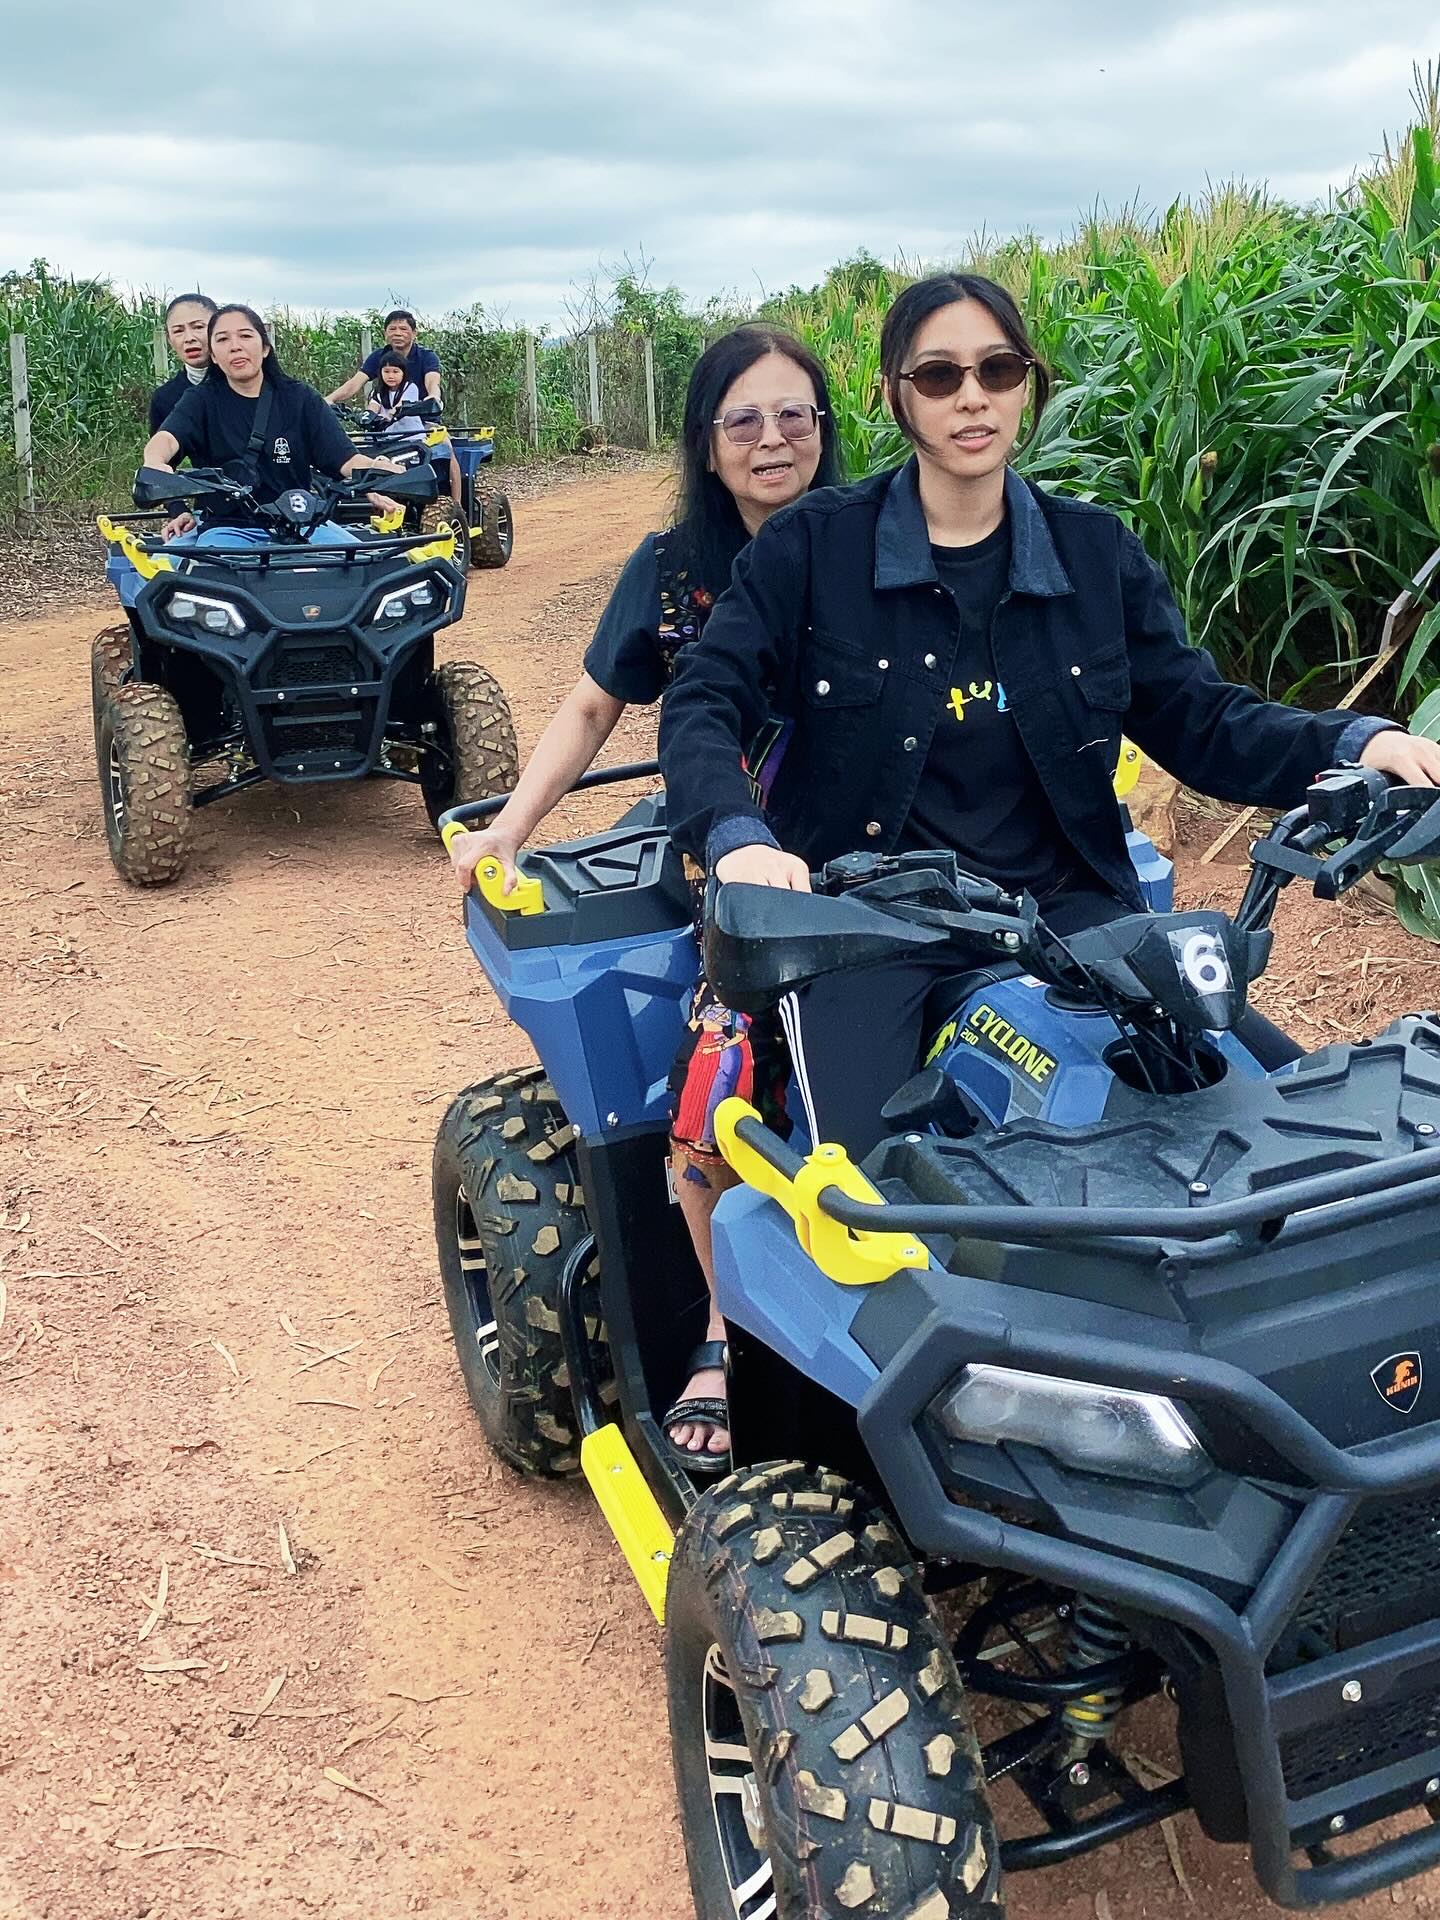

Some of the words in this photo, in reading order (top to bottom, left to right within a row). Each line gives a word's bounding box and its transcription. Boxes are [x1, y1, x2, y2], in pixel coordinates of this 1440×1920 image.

[291, 495, 306, 512] 3
[1183, 934, 1227, 992] 6
[960, 1028, 979, 1046] 200
[969, 1003, 1056, 1083] CYCLONE
